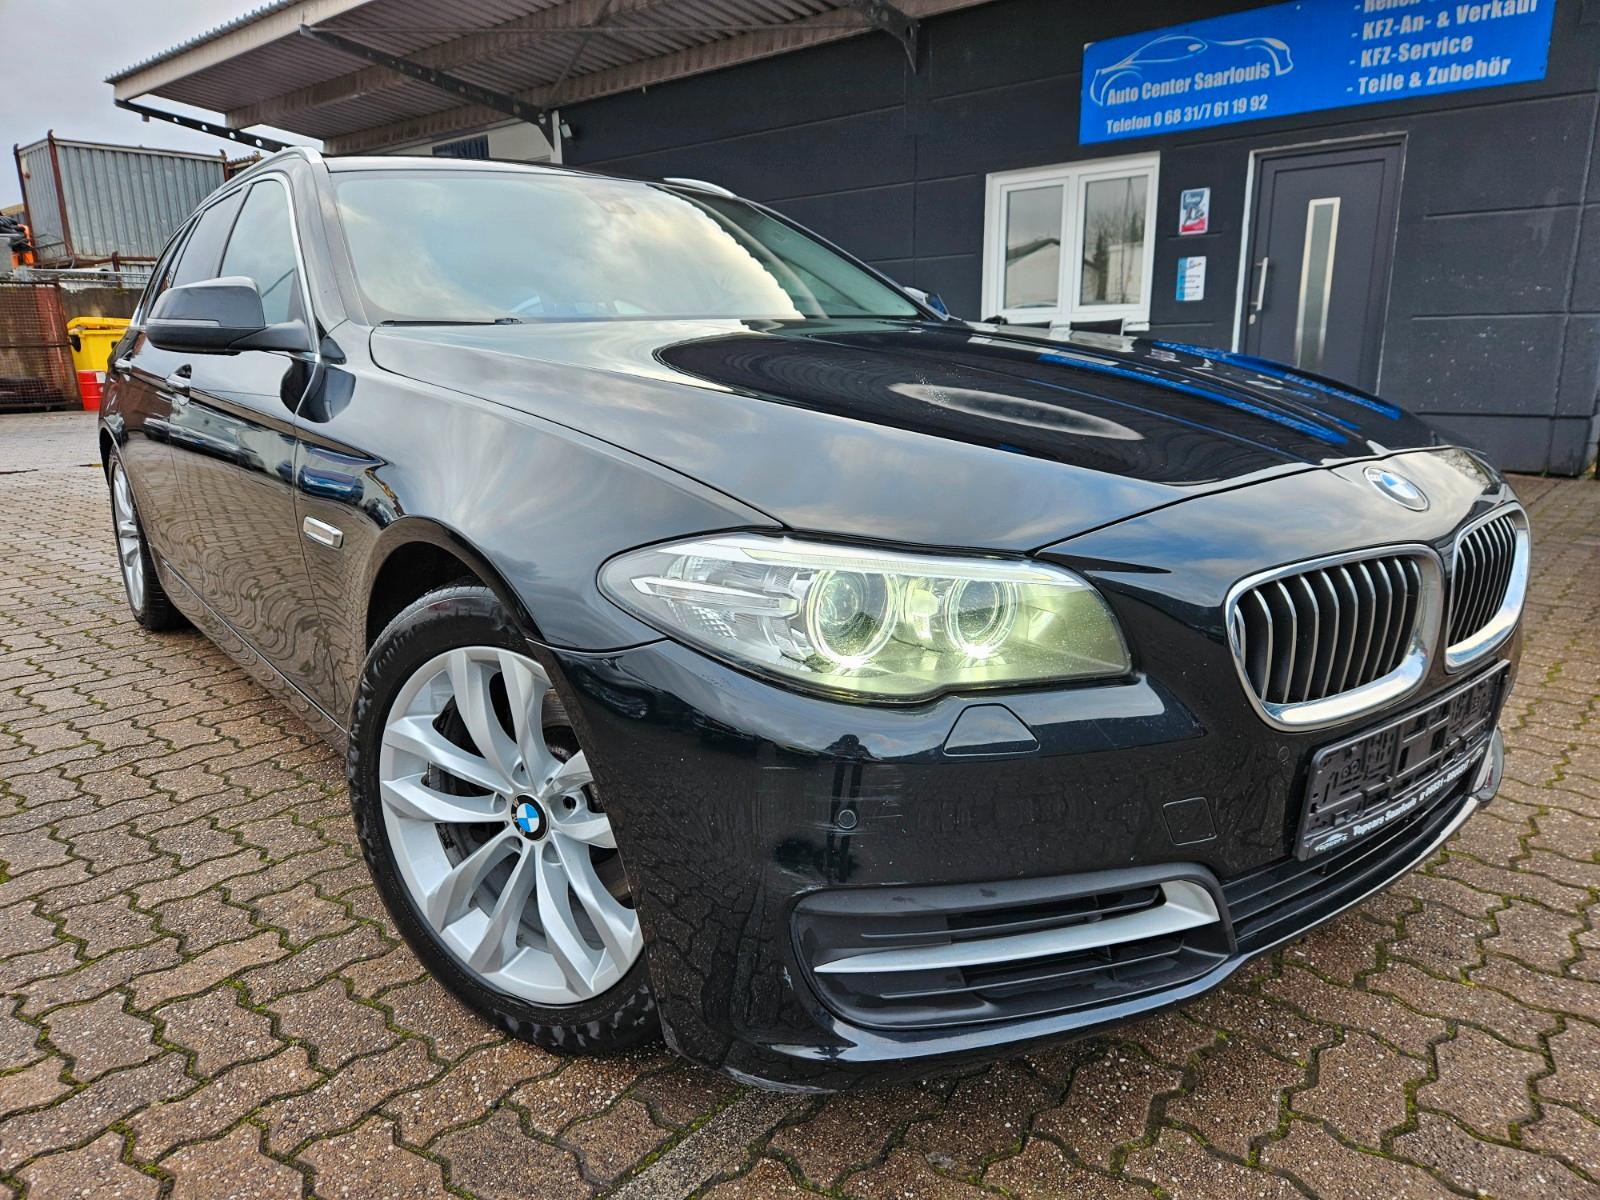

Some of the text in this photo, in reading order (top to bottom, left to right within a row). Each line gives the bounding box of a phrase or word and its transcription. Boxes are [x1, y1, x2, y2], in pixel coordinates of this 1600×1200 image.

[1436, 11, 1450, 28] &
[1360, 35, 1473, 68] KFZ-Service
[1107, 62, 1270, 106] Auto Center Saarlouis
[1358, 73, 1404, 95] Teile
[1409, 71, 1422, 88] &
[1427, 56, 1511, 86] Zubehör
[1106, 114, 1151, 134] Telefon
